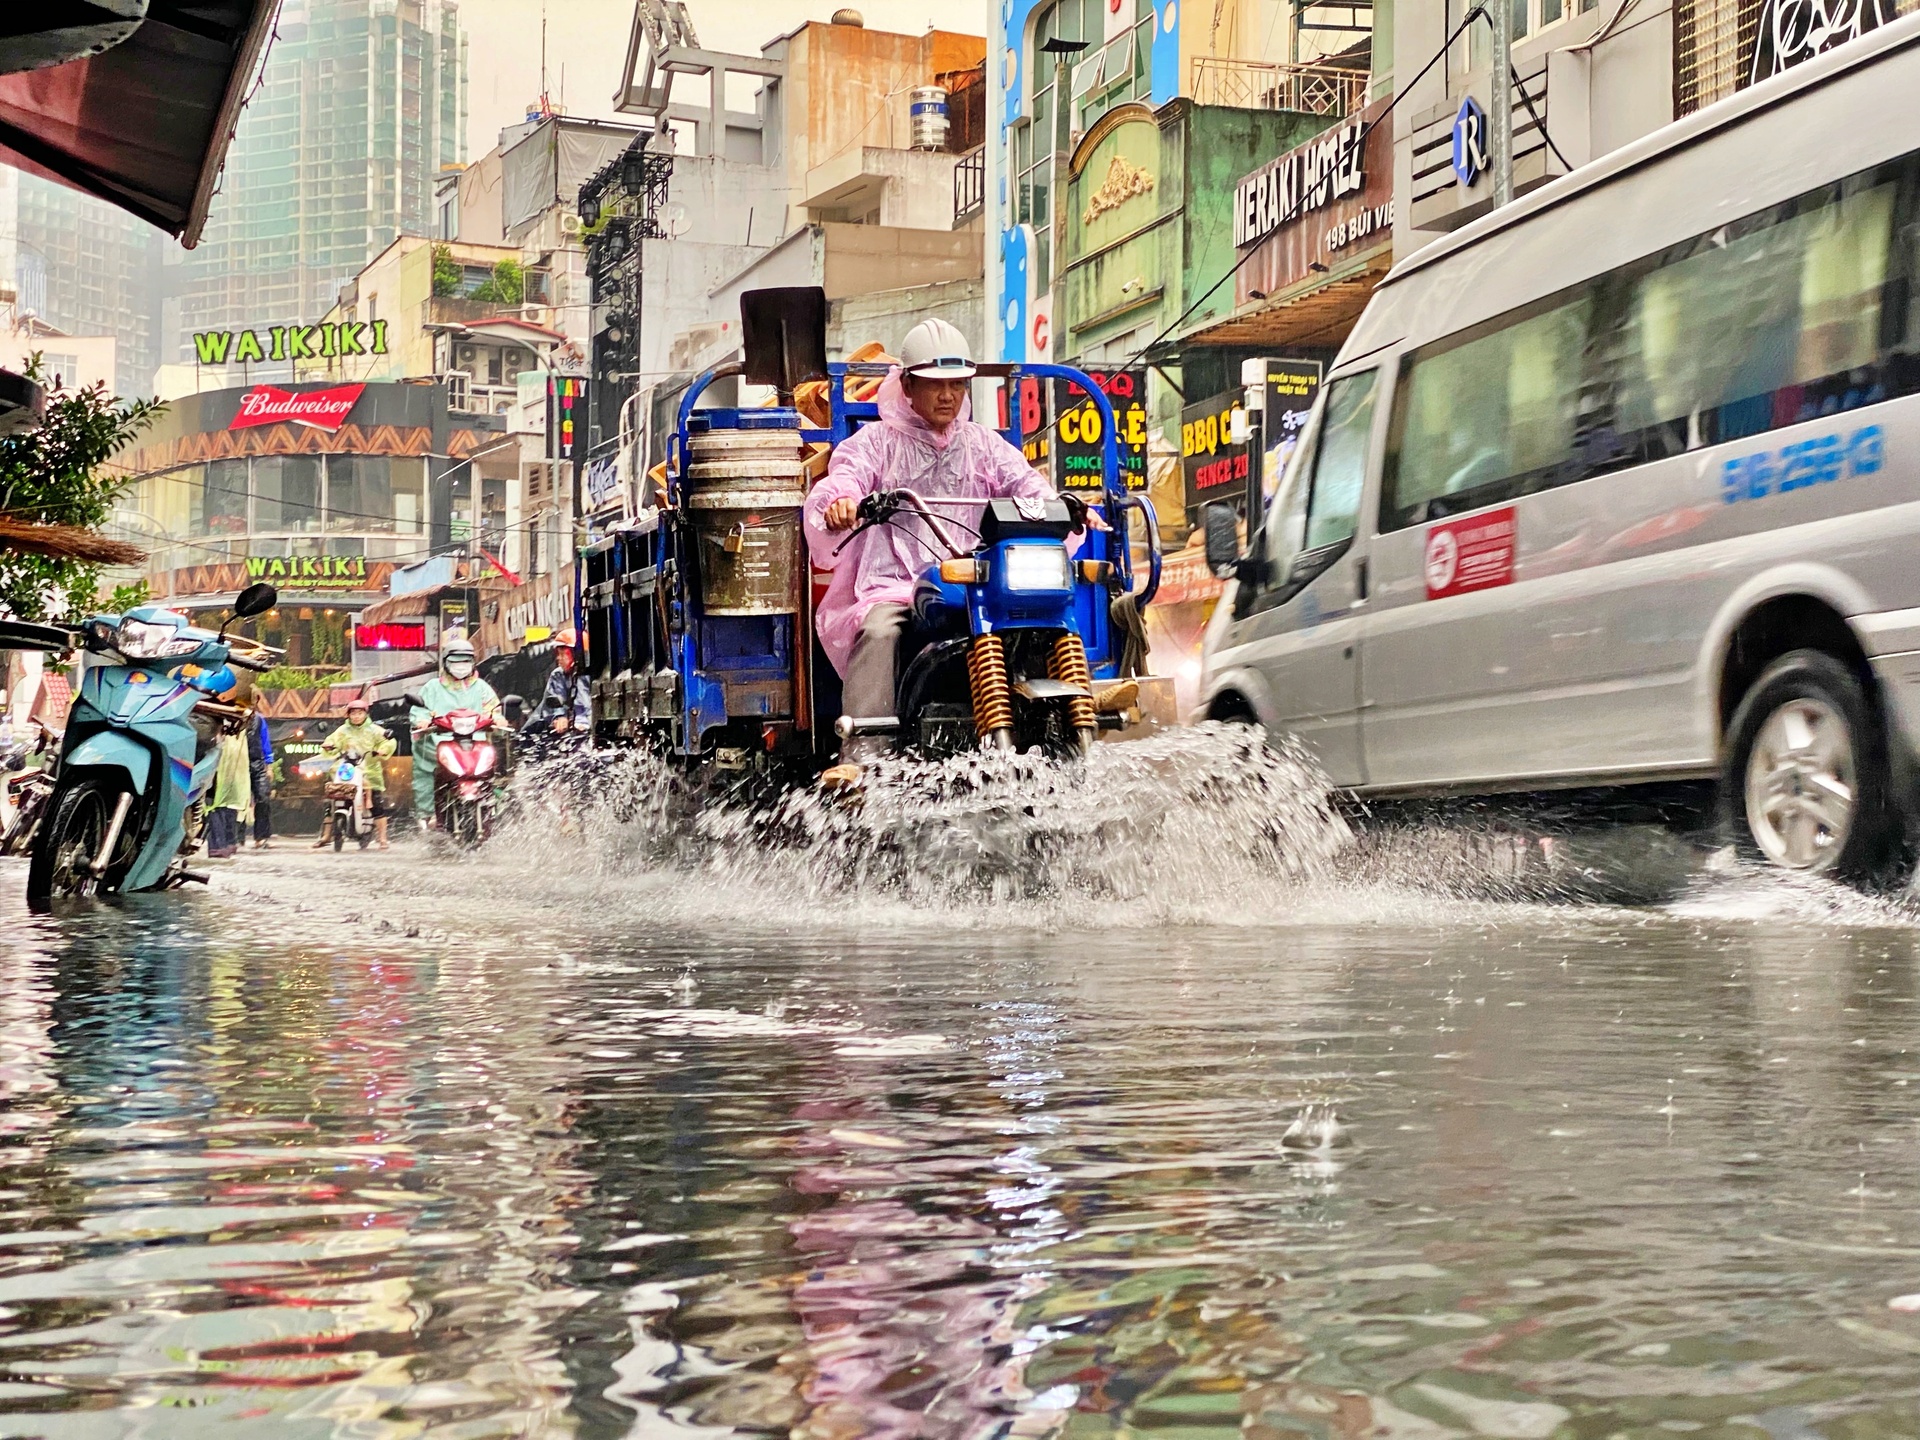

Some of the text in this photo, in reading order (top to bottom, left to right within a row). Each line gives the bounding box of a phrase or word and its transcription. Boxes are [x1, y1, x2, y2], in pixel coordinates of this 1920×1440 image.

[1458, 115, 1487, 170] R
[1233, 121, 1362, 248] MERAKI HOTEL
[1325, 192, 1394, 251] 198 BÙI VIỆ
[194, 320, 388, 364] WAIKIKI
[240, 393, 352, 416] Budweiser
[1059, 401, 1102, 444] CÔ
[1183, 415, 1217, 458] BBQ
[1065, 475, 1088, 487] 198
[1196, 458, 1231, 490] SINCE
[246, 556, 365, 577] WAIKIKI
[288, 579, 365, 587] RESTAURANT
[284, 744, 323, 754] WAIKI
